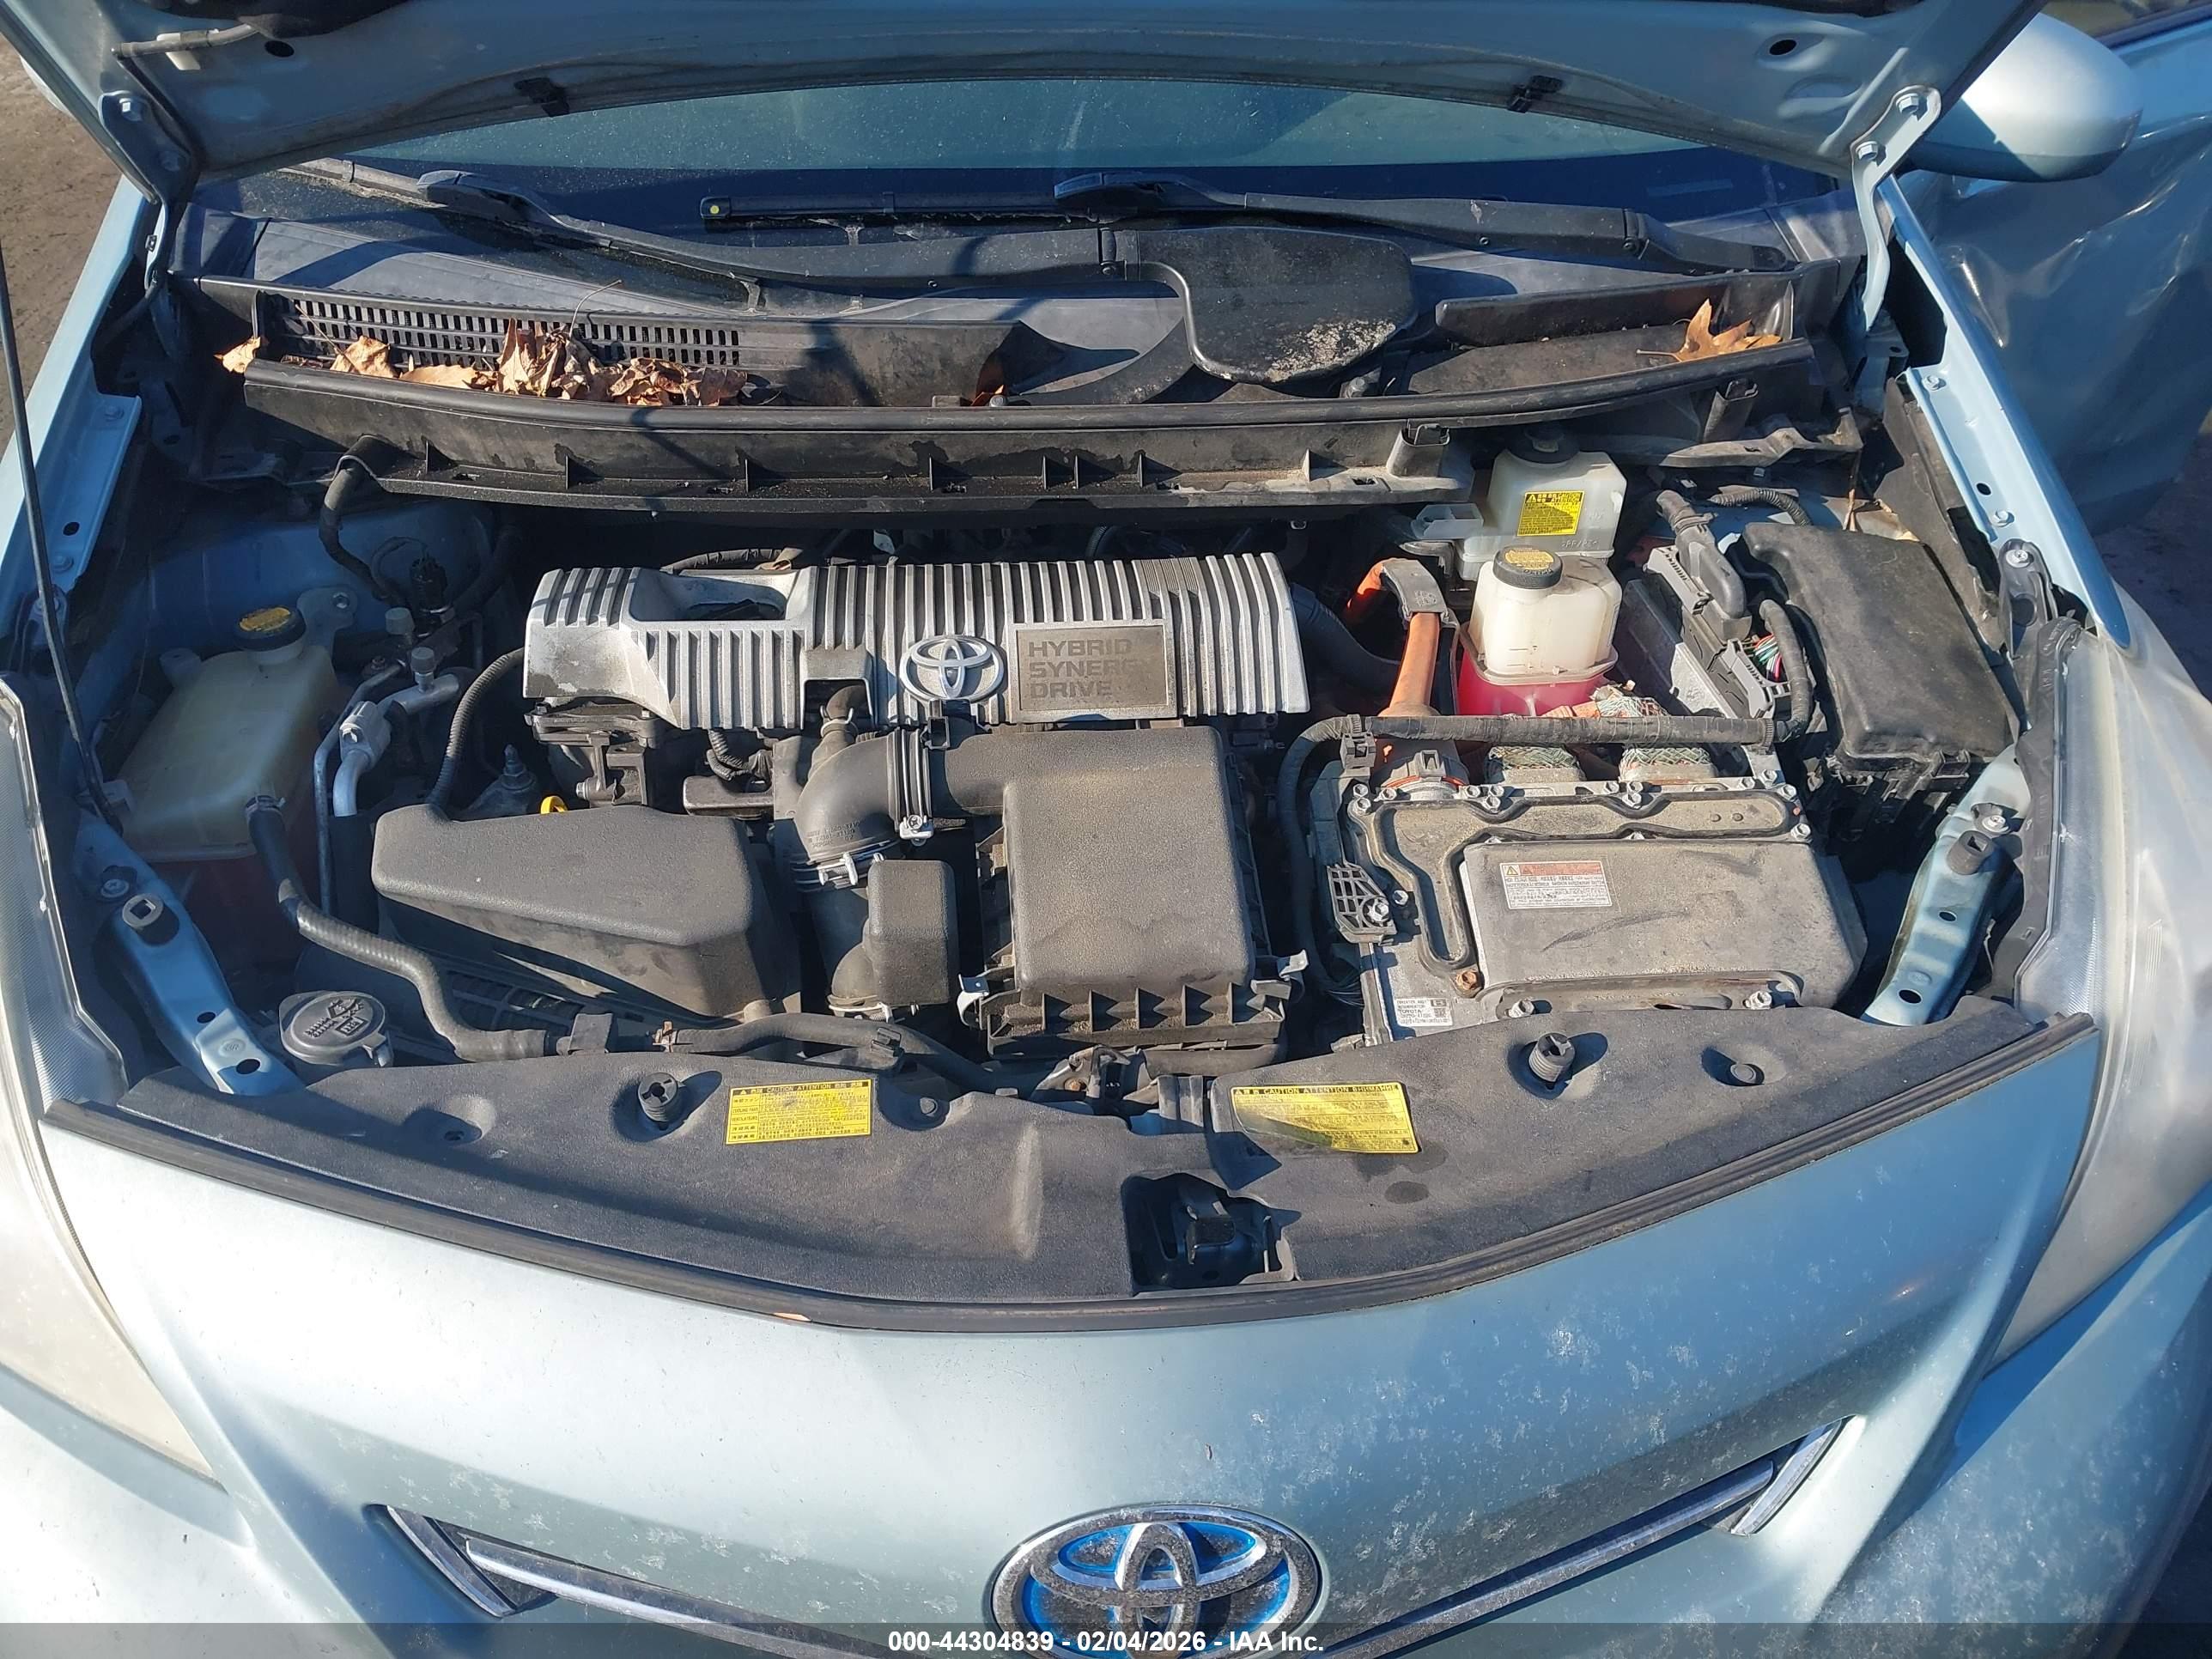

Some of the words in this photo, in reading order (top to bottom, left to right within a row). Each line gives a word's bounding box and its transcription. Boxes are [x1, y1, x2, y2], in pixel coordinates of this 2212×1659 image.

[1029, 638, 1132, 658] HYBRID
[1030, 681, 1114, 699] DRIVE
[767, 1085, 794, 1094] CAUTION
[797, 1083, 831, 1091] ATTENTION
[1304, 1086, 1349, 1095] ATTENTION
